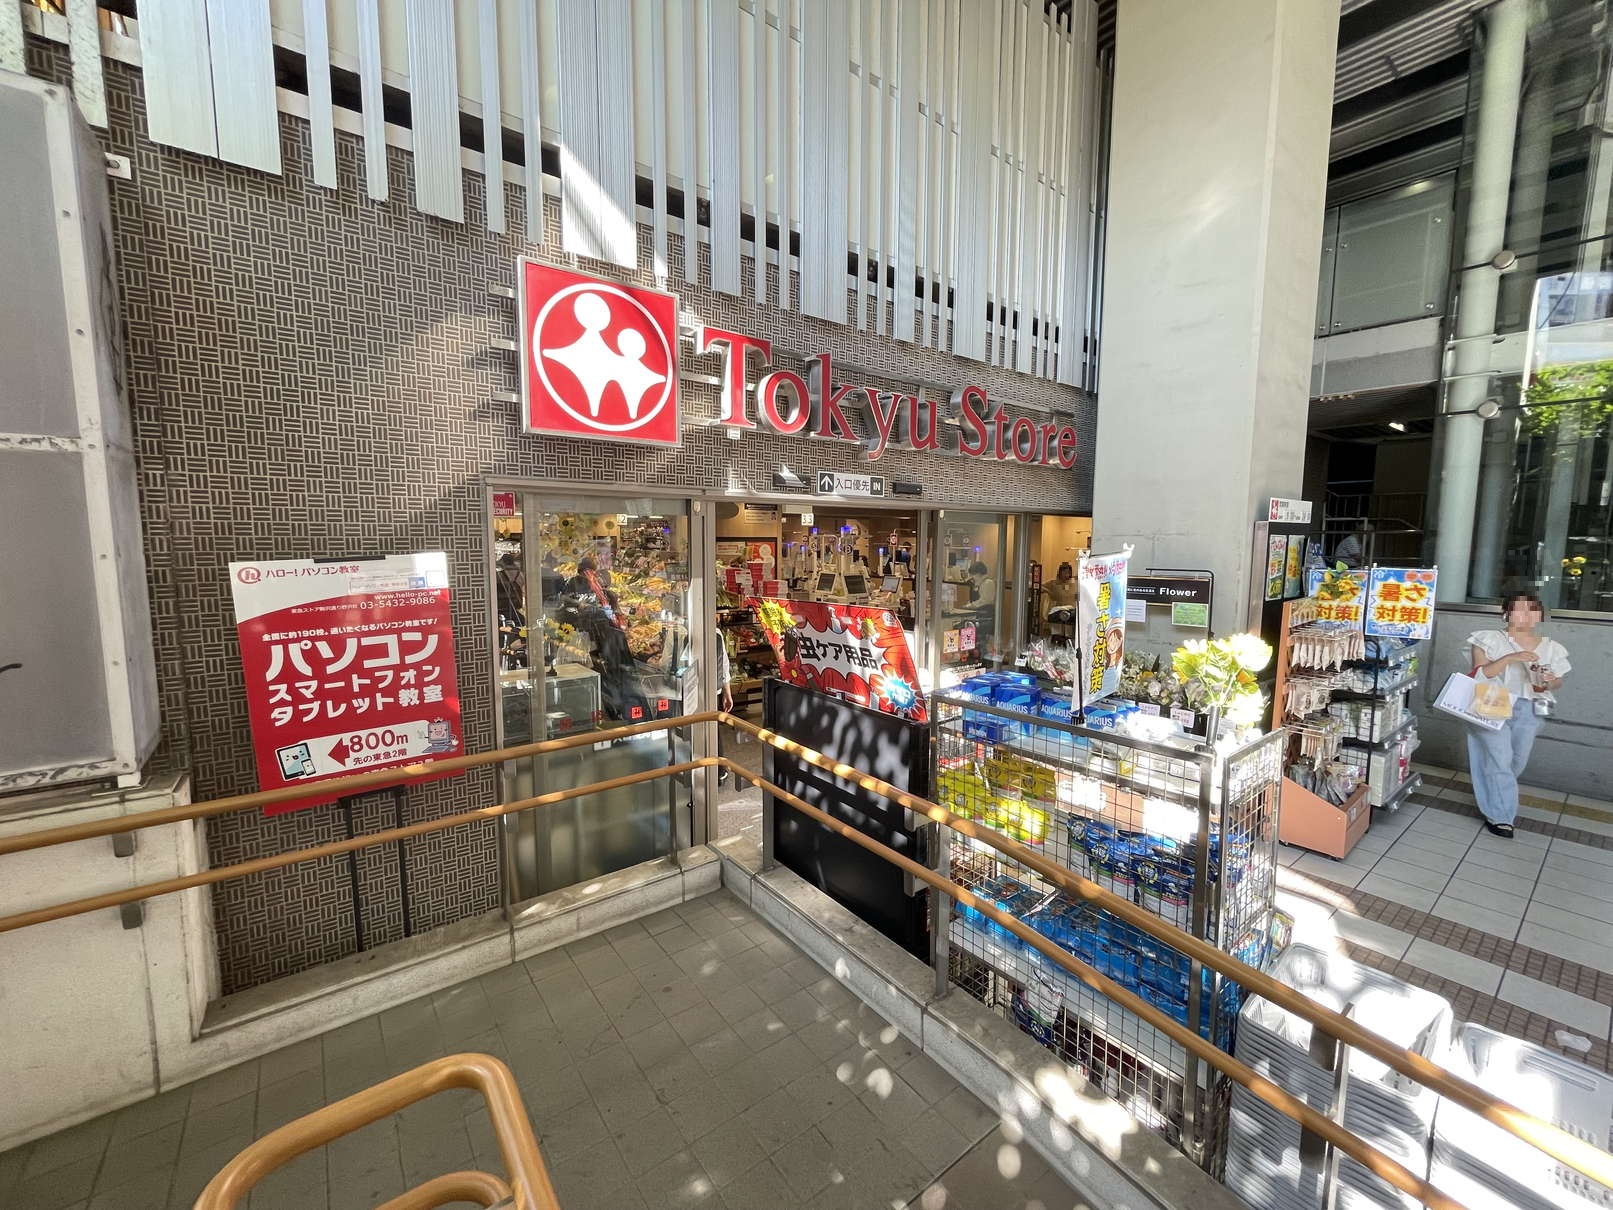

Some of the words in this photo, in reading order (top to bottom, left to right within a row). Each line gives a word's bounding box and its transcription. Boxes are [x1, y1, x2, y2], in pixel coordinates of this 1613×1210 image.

[702, 326, 939, 461] Tokyu
[957, 385, 1078, 469] Store
[835, 478, 869, 491] 入口優先
[872, 481, 881, 491] IN
[373, 589, 441, 600] www.hello-pc.net
[1159, 587, 1198, 597] Flower
[1379, 582, 1427, 603] 暑さ
[360, 596, 436, 610] 03-5432-9086
[1375, 604, 1428, 624] 対策!
[1088, 581, 1112, 695] 暑さ対策
[266, 632, 438, 682] パソコン
[799, 632, 878, 670] 虫ケア用品
[268, 665, 441, 704] スマートフォン
[271, 684, 444, 727] タブレット教室
[996, 700, 1029, 714] AQUARIUS
[350, 729, 408, 753] 800m
[353, 748, 408, 766] 先の東急2階
